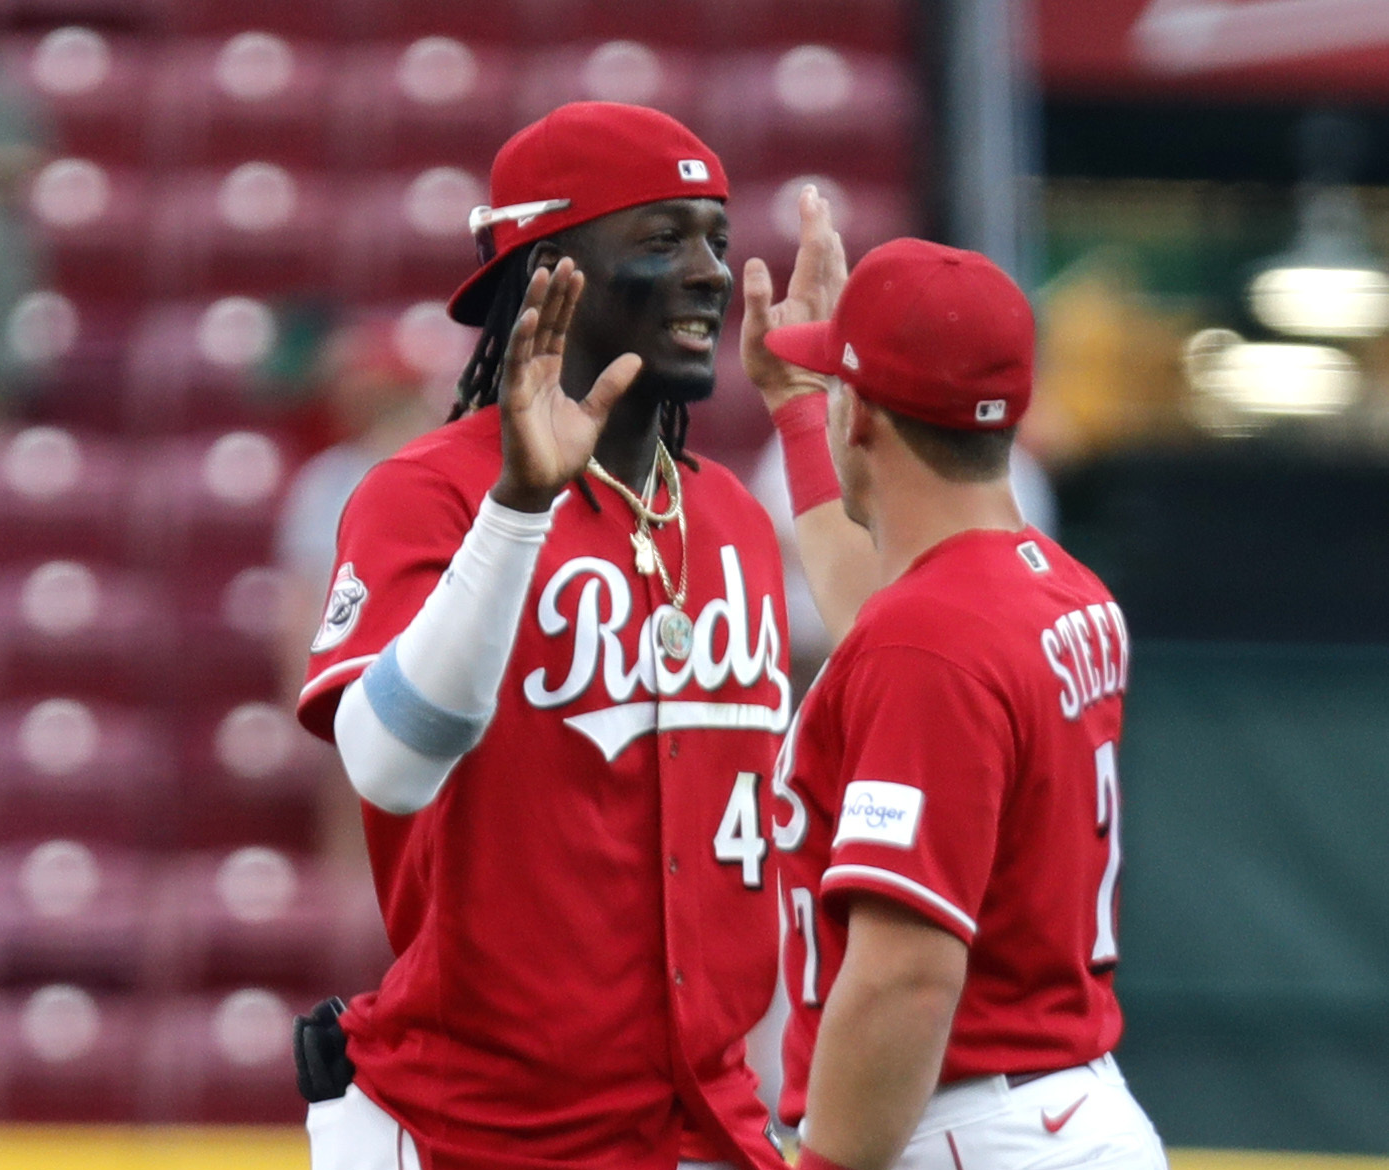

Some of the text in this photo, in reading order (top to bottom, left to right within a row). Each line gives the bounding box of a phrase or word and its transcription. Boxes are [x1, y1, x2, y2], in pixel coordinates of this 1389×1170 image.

[523, 545, 792, 735] Reds
[791, 887, 821, 1007] 7
[1091, 740, 1122, 973] 7
